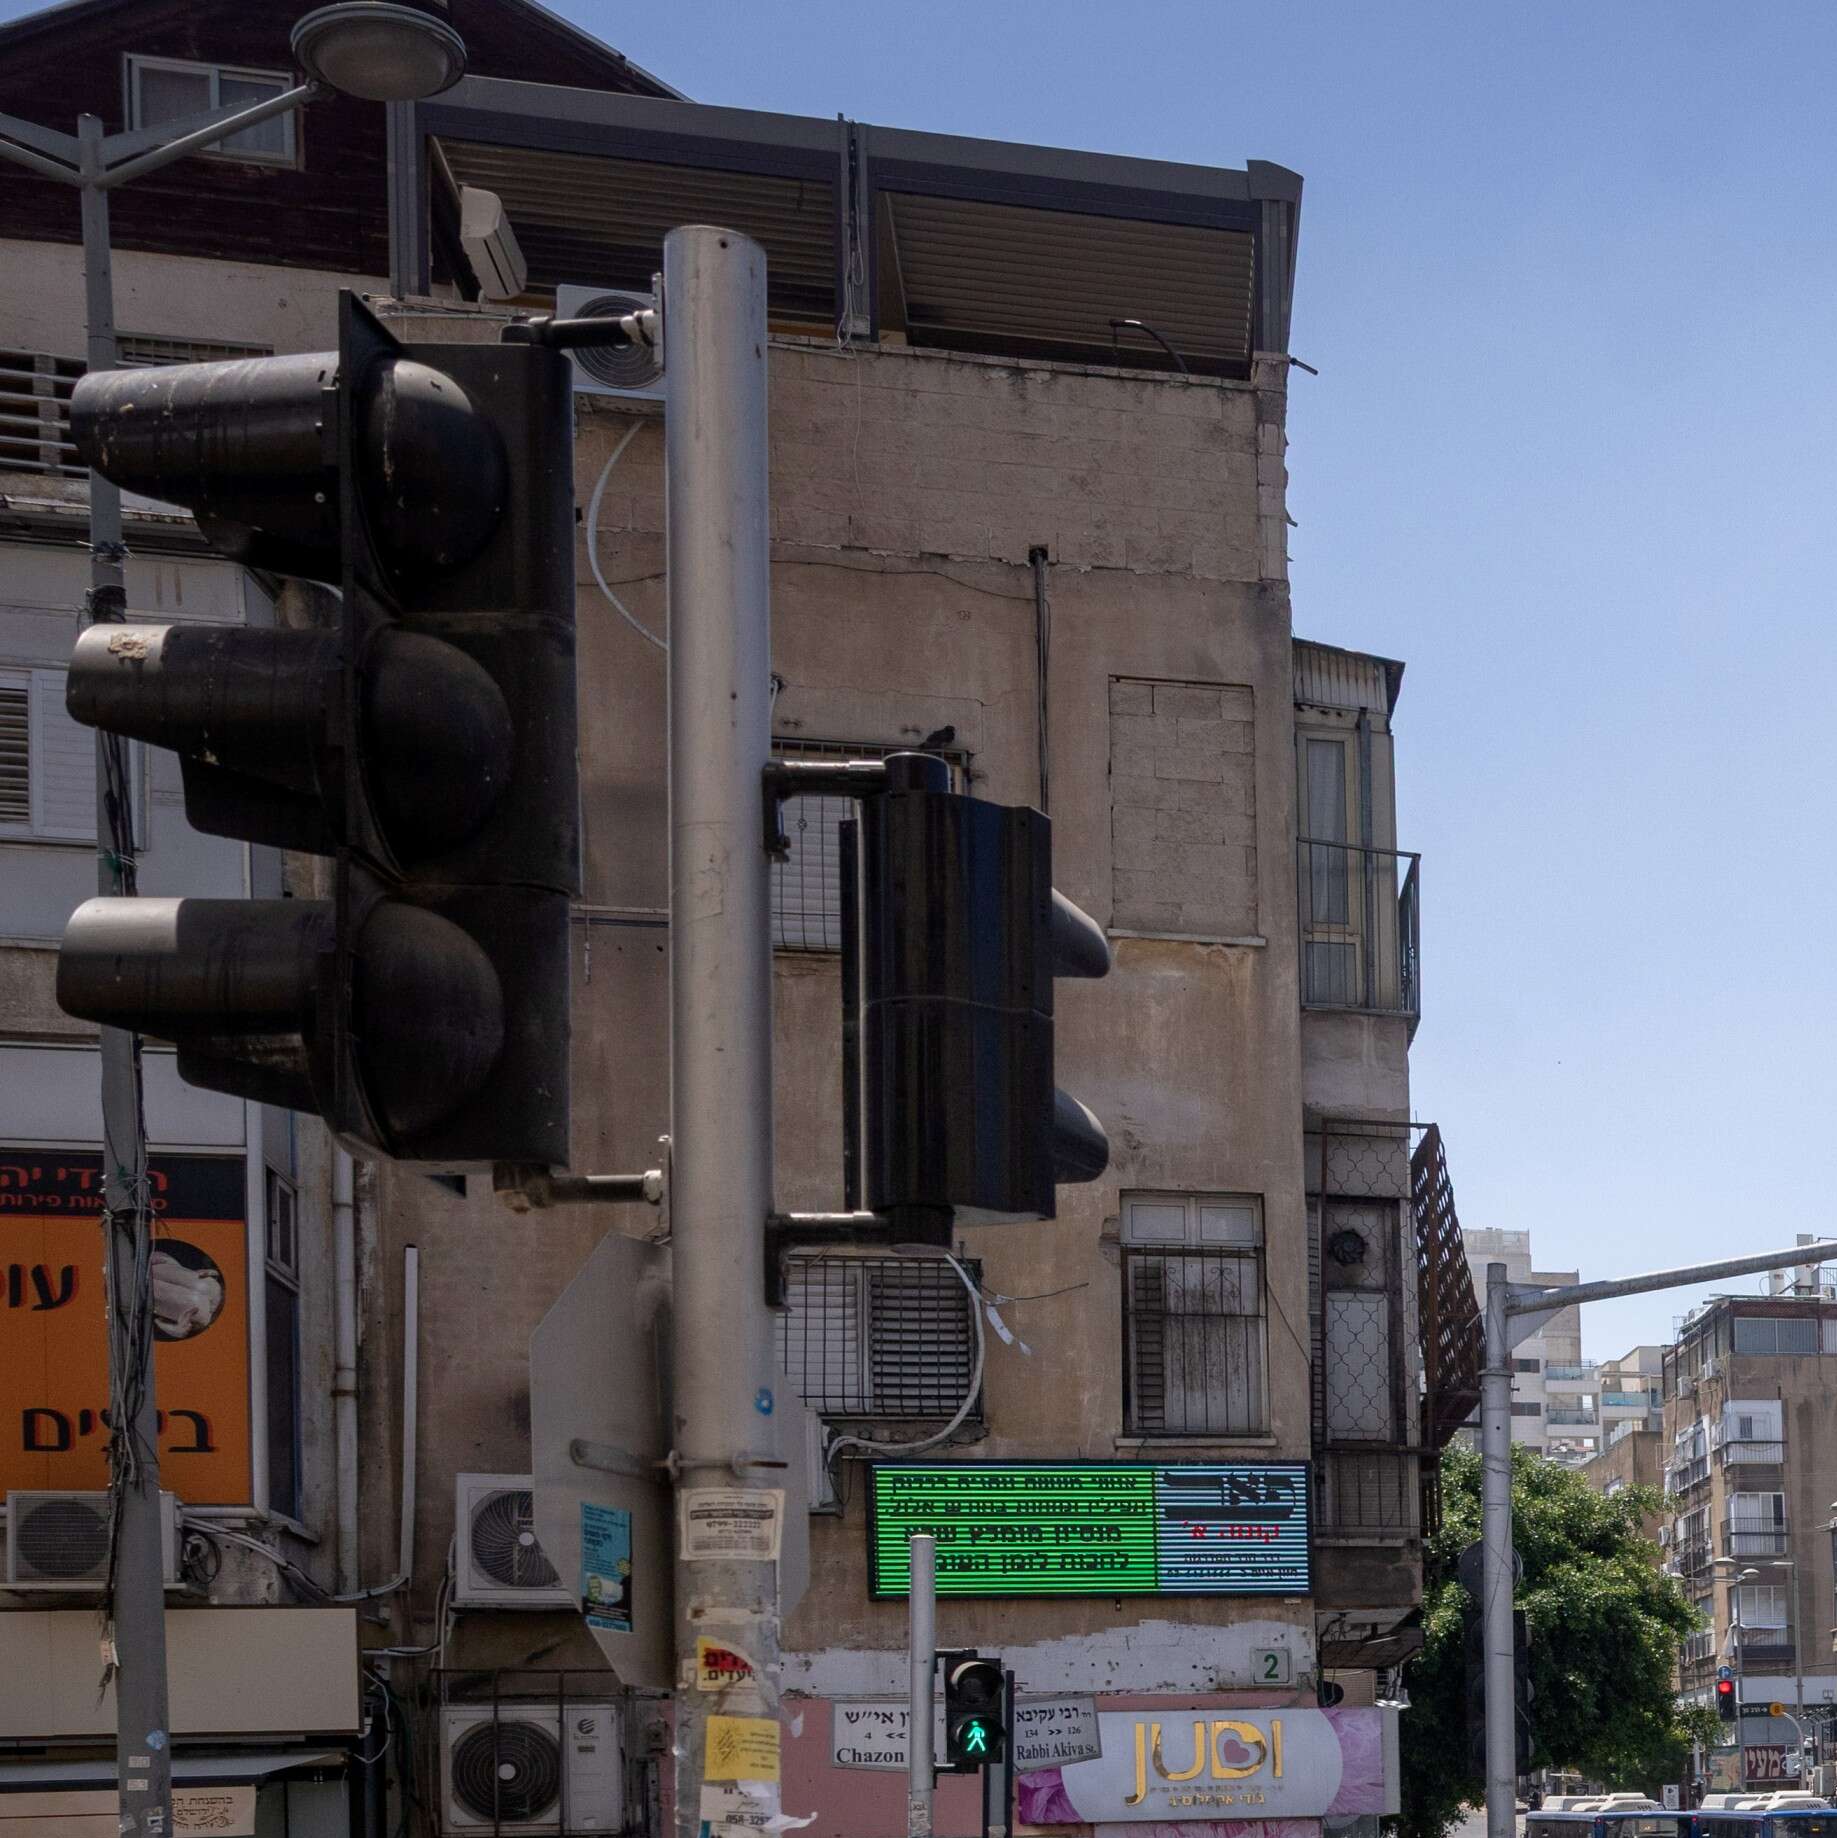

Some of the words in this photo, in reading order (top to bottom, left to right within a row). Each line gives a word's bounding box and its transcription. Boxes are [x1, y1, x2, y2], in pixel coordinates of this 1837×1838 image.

[0, 1262, 80, 1311] עו
[22, 1407, 216, 1453] ביים
[1264, 1653, 1280, 1681] 2
[1016, 1709, 1056, 1725] עקיבא
[1059, 1708, 1080, 1720] רבי
[864, 1732, 872, 1740] 4
[836, 1747, 905, 1764] Chazon
[1016, 1743, 1050, 1760] Rabbi
[1052, 1741, 1084, 1759] Akiva
[1124, 1719, 1283, 1808] JUDI
